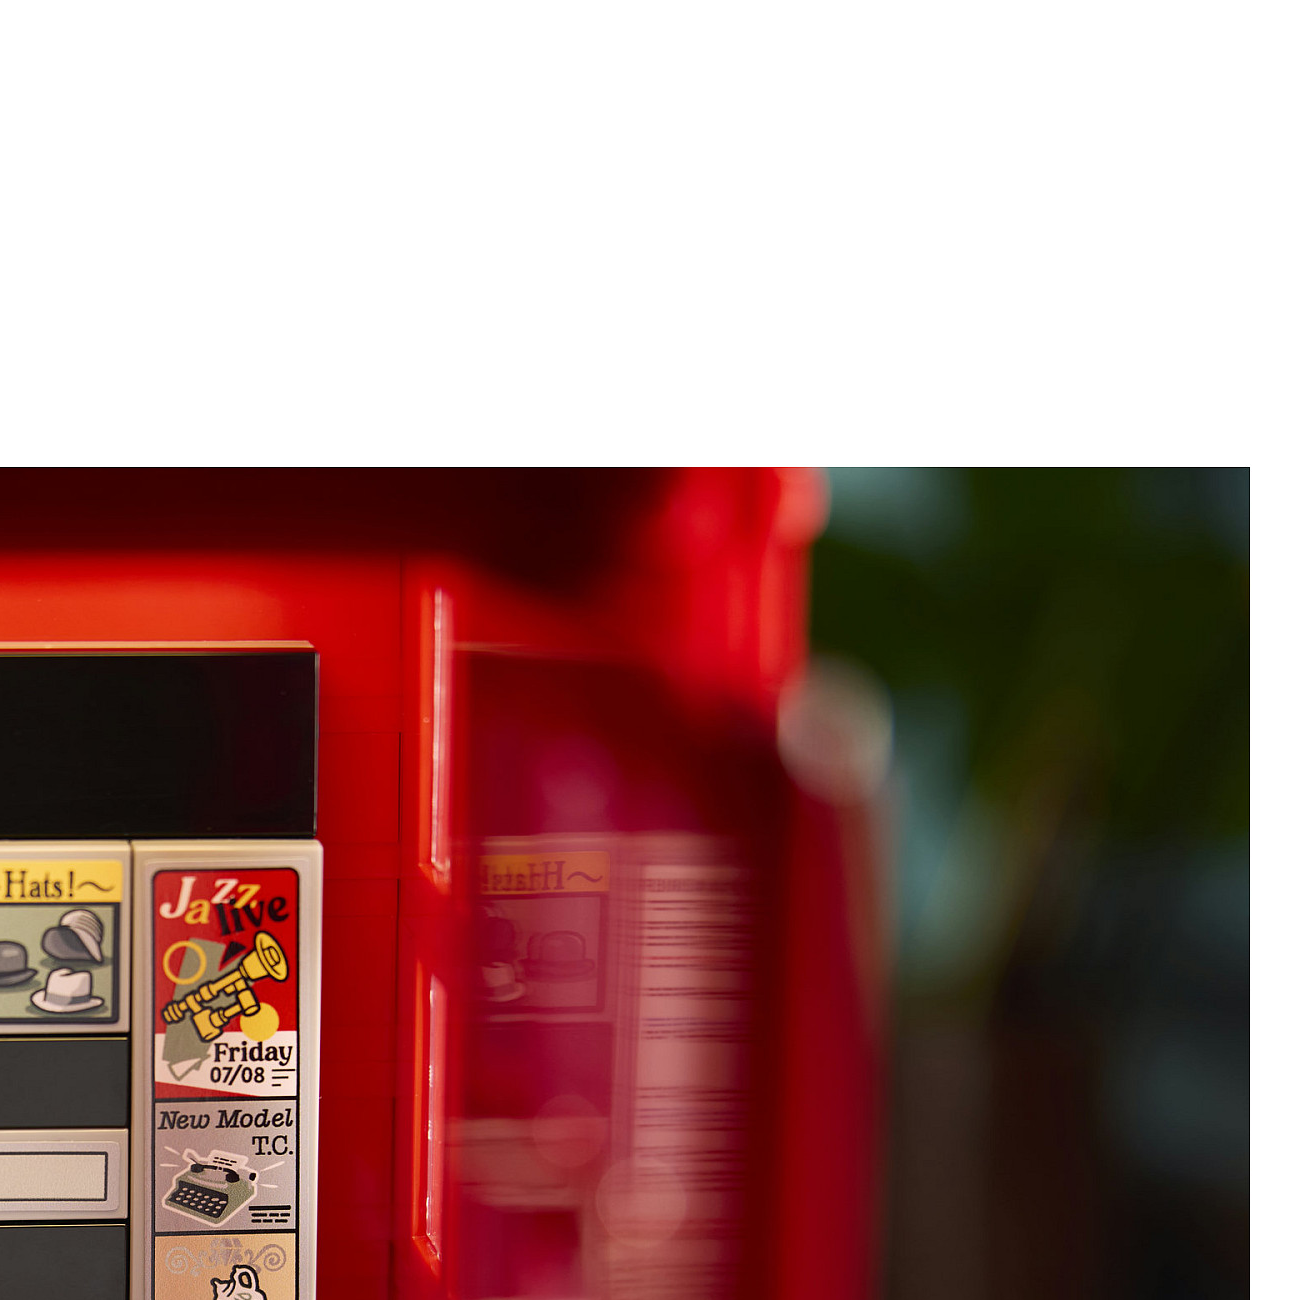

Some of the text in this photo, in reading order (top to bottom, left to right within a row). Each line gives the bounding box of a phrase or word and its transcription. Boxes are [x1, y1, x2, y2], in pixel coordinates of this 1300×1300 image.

[3, 870, 75, 898] Hats!
[159, 876, 261, 924] Jazz
[215, 896, 289, 936] live
[214, 1041, 293, 1066] Friday
[210, 1064, 265, 1086] 07/08
[157, 1108, 294, 1130] New Model
[252, 1135, 294, 1156] T.C.
